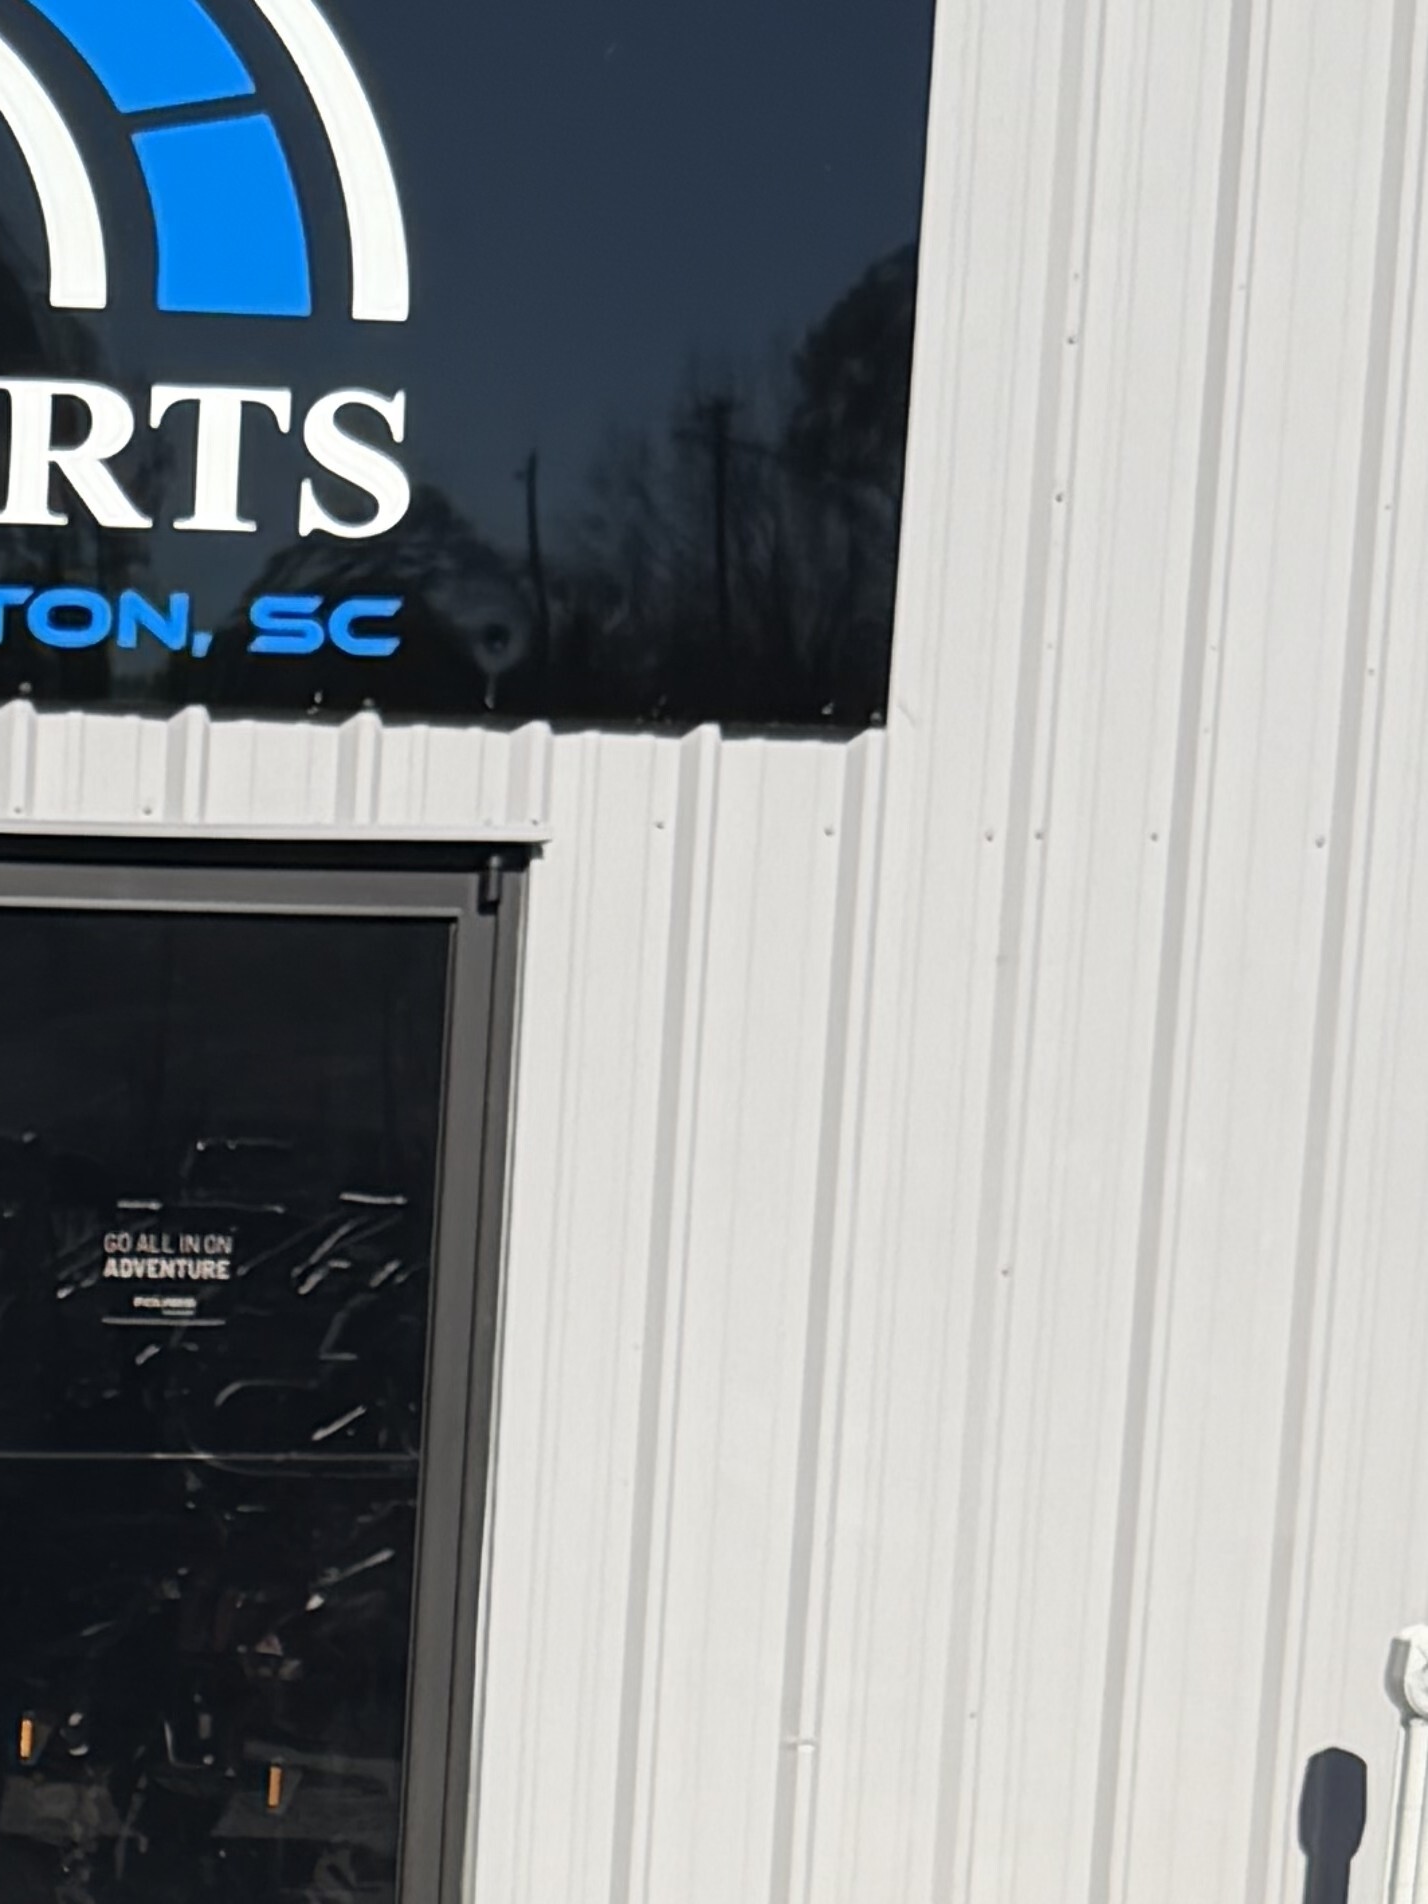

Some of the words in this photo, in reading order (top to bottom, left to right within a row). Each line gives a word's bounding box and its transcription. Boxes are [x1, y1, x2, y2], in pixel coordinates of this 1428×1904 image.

[251, 596, 399, 655] SC
[104, 1232, 132, 1253] GO
[136, 1233, 174, 1254] ALL
[180, 1233, 200, 1254] IN
[204, 1234, 233, 1254] ON
[103, 1257, 231, 1280] ADVENTURE
